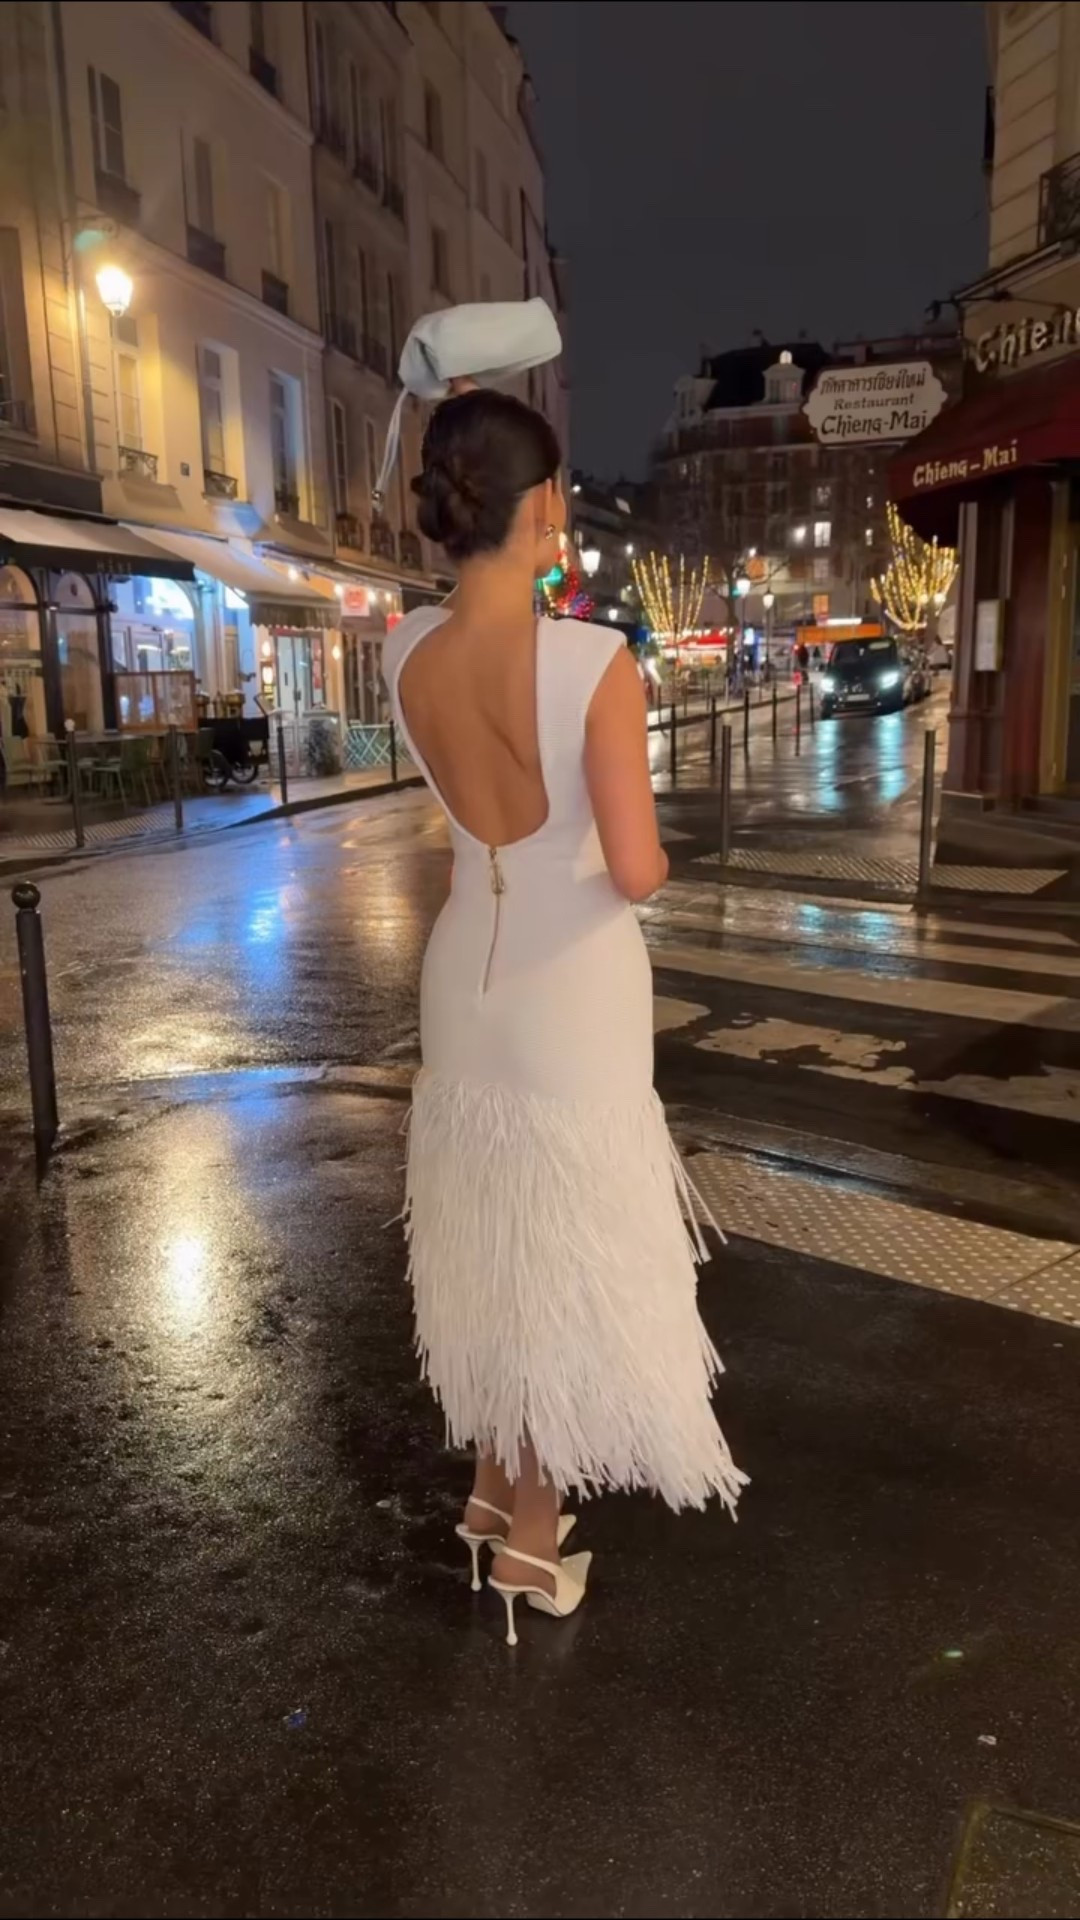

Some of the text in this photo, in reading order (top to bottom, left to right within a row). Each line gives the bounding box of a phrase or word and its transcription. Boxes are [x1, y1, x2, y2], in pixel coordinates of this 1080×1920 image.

[974, 307, 1080, 374] Chien
[833, 392, 915, 411] Restaurant
[820, 410, 928, 438] Chieng-Mai
